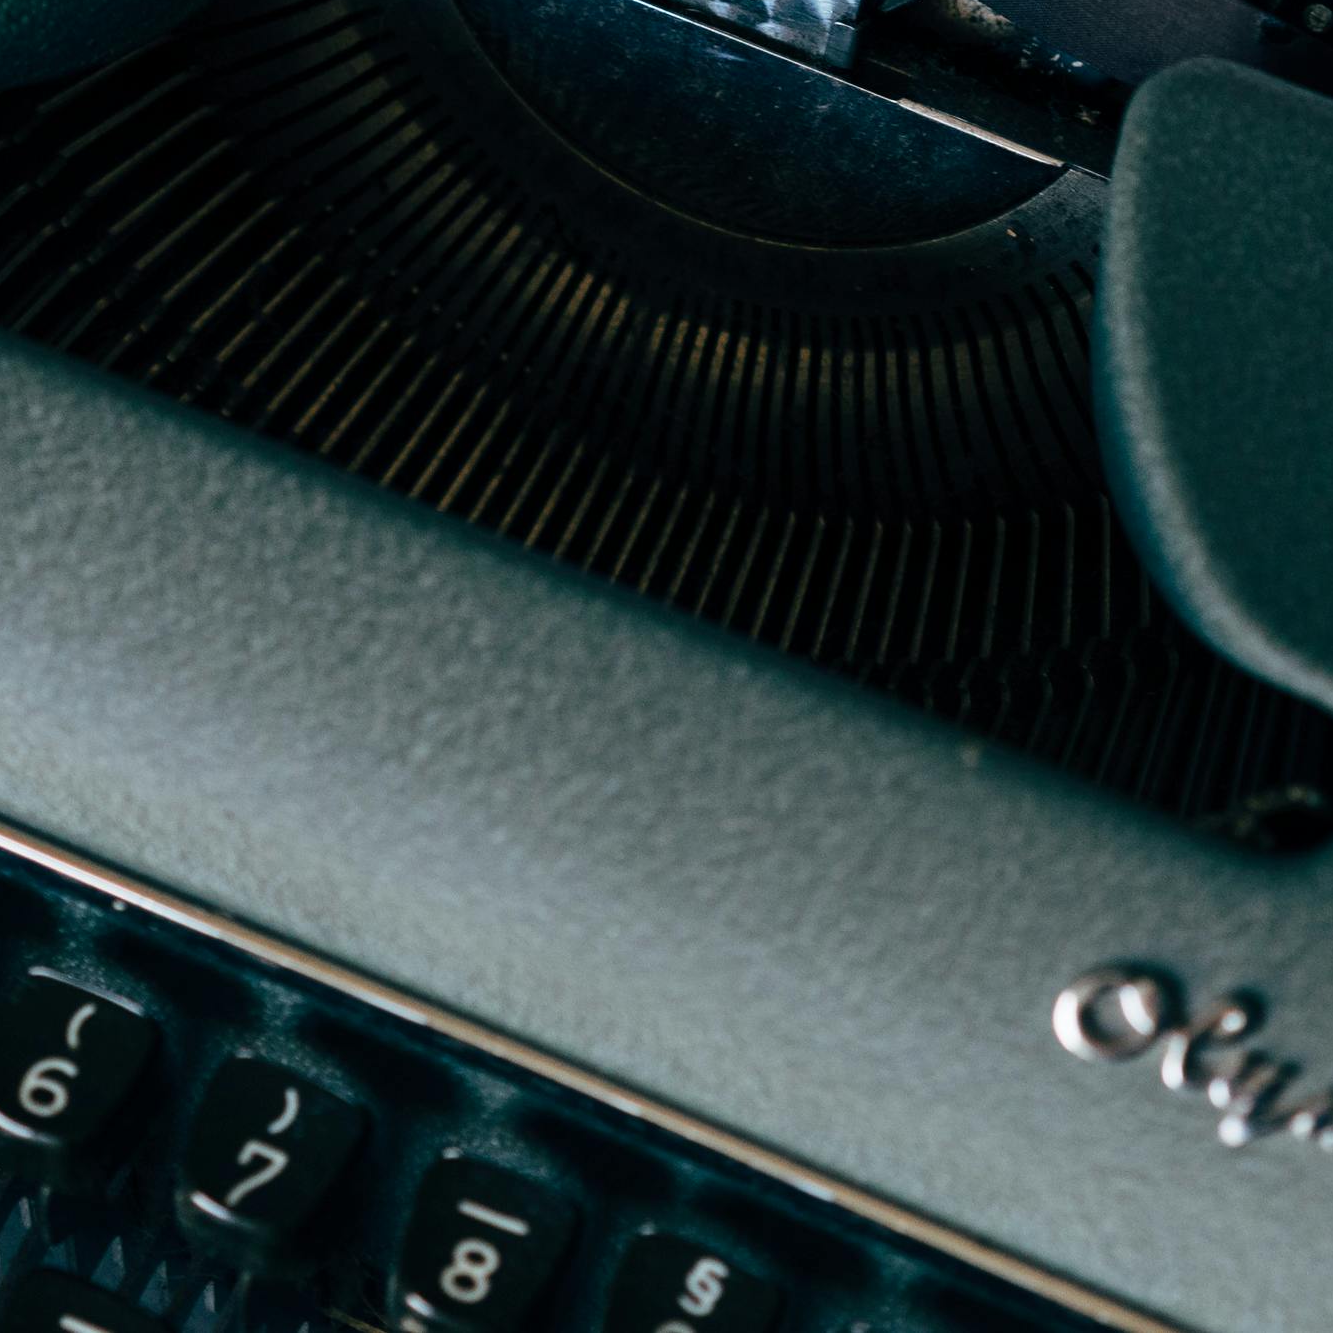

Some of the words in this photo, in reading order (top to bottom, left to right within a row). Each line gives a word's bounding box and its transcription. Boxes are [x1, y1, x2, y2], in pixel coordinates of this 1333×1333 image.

[19, 1058, 78, 1117] 6
[228, 1141, 288, 1204] 7
[441, 1240, 499, 1302] 8
